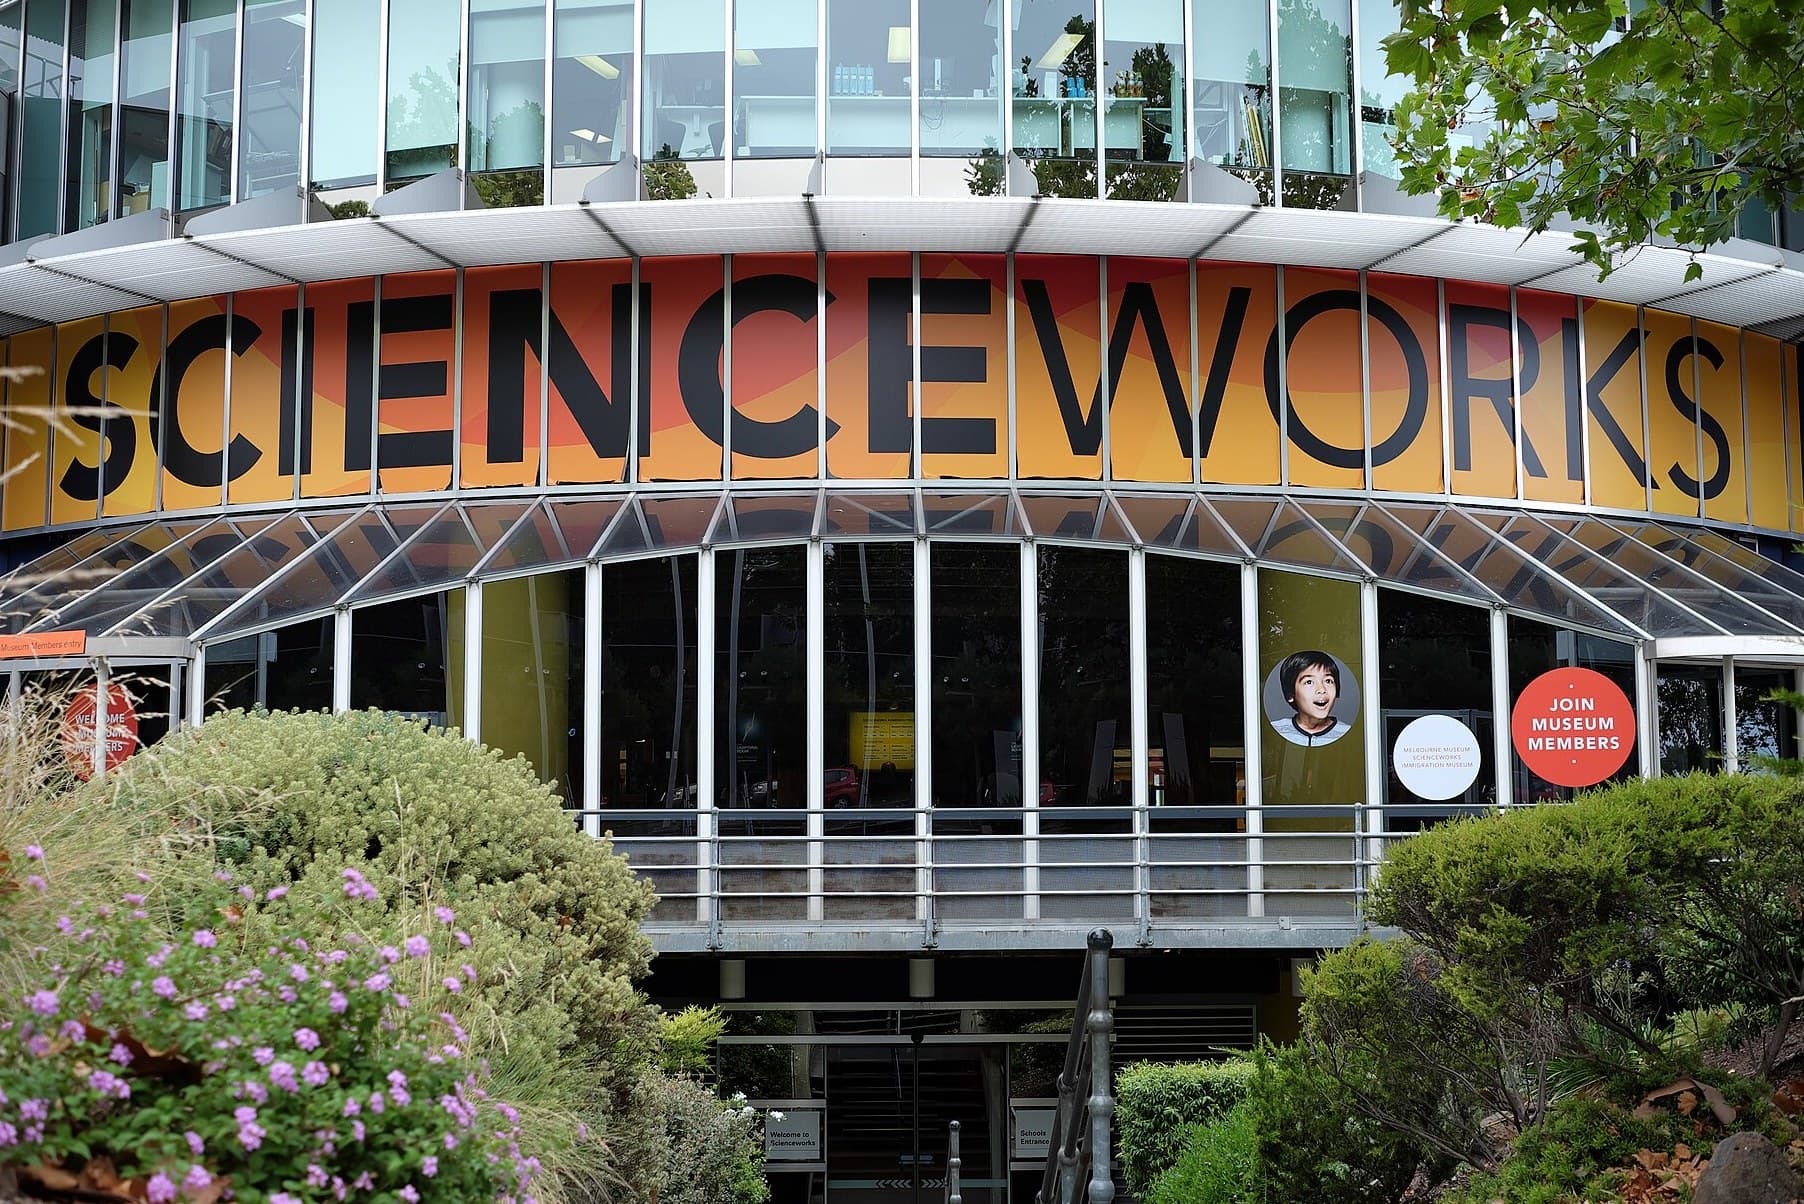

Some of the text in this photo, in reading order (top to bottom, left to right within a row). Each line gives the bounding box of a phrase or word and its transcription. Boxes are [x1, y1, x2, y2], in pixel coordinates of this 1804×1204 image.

[59, 274, 1731, 501] SCIENCEWORKS
[31, 641, 62, 650] Members
[64, 640, 80, 648] entry
[1550, 698, 1594, 711] JOIN
[1532, 717, 1614, 731] MUSEUM
[1528, 736, 1620, 750] MEMBERS
